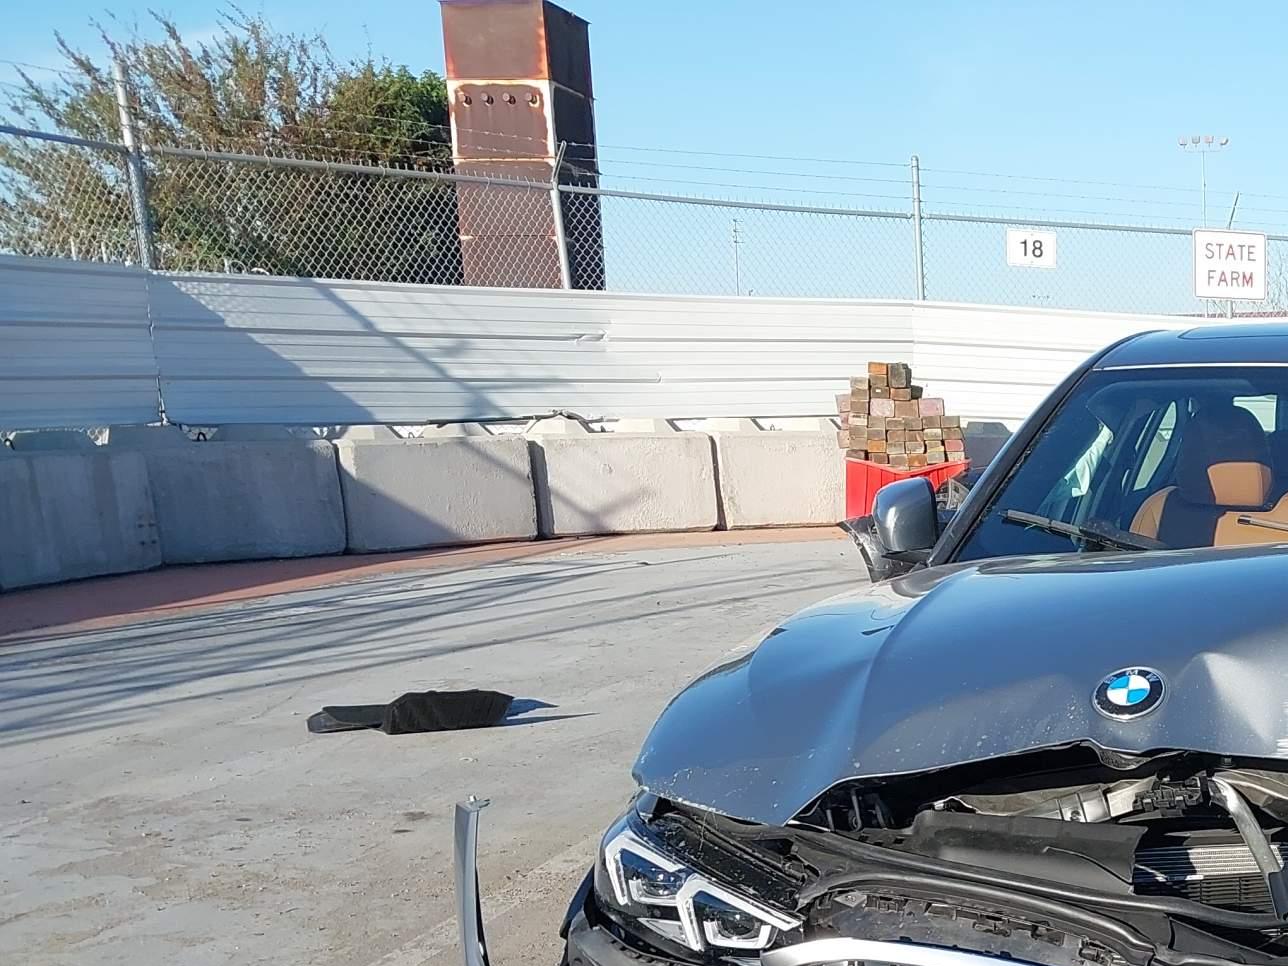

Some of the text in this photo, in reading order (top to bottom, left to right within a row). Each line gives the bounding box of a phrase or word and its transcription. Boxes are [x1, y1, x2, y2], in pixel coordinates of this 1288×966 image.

[1020, 239, 1044, 259] 18
[1205, 242, 1257, 262] STATE
[1207, 269, 1254, 289] FARM
[1103, 668, 1161, 685] BMW
